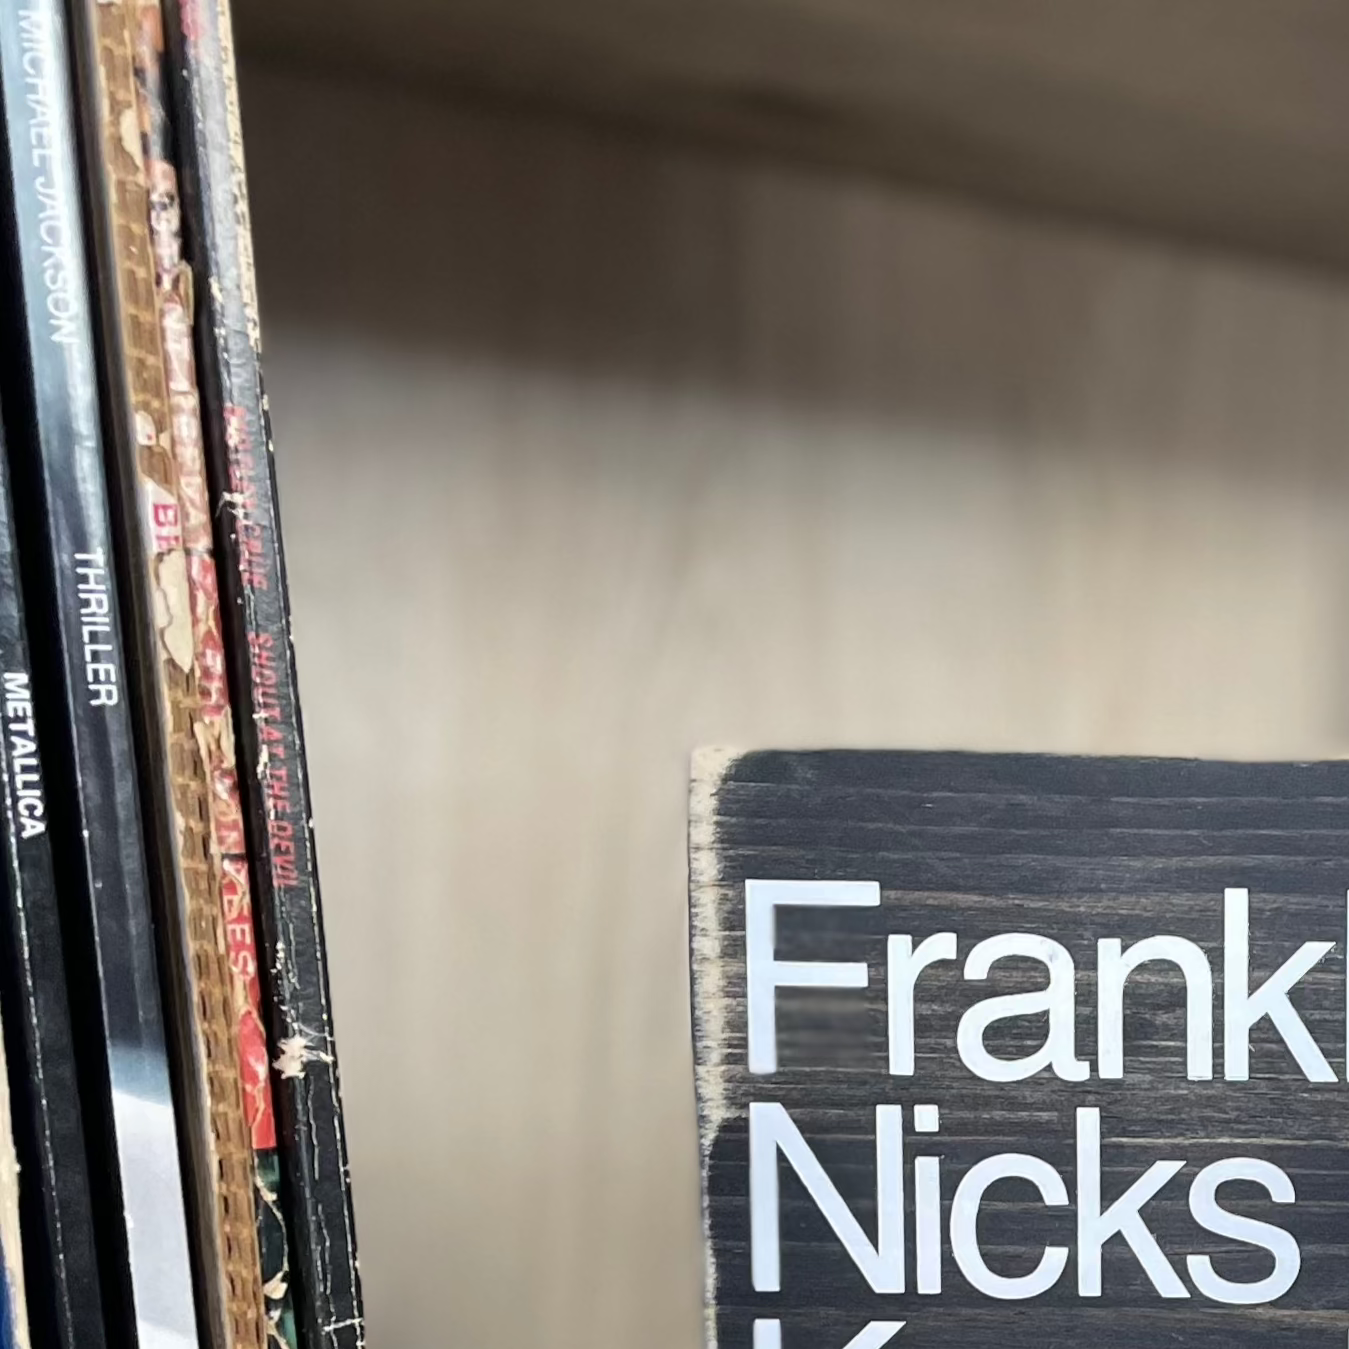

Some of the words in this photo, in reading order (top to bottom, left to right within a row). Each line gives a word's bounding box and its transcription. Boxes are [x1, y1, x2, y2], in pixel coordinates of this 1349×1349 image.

[17, 9, 53, 166] MICHAEL
[34, 176, 79, 344] JACKSON
[73, 547, 118, 709] THRILLER
[1, 671, 47, 839] METALLICA
[249, 632, 283, 721] SHOUT
[269, 819, 298, 888] DEVIL
[749, 1102, 1301, 1305] Nicks
